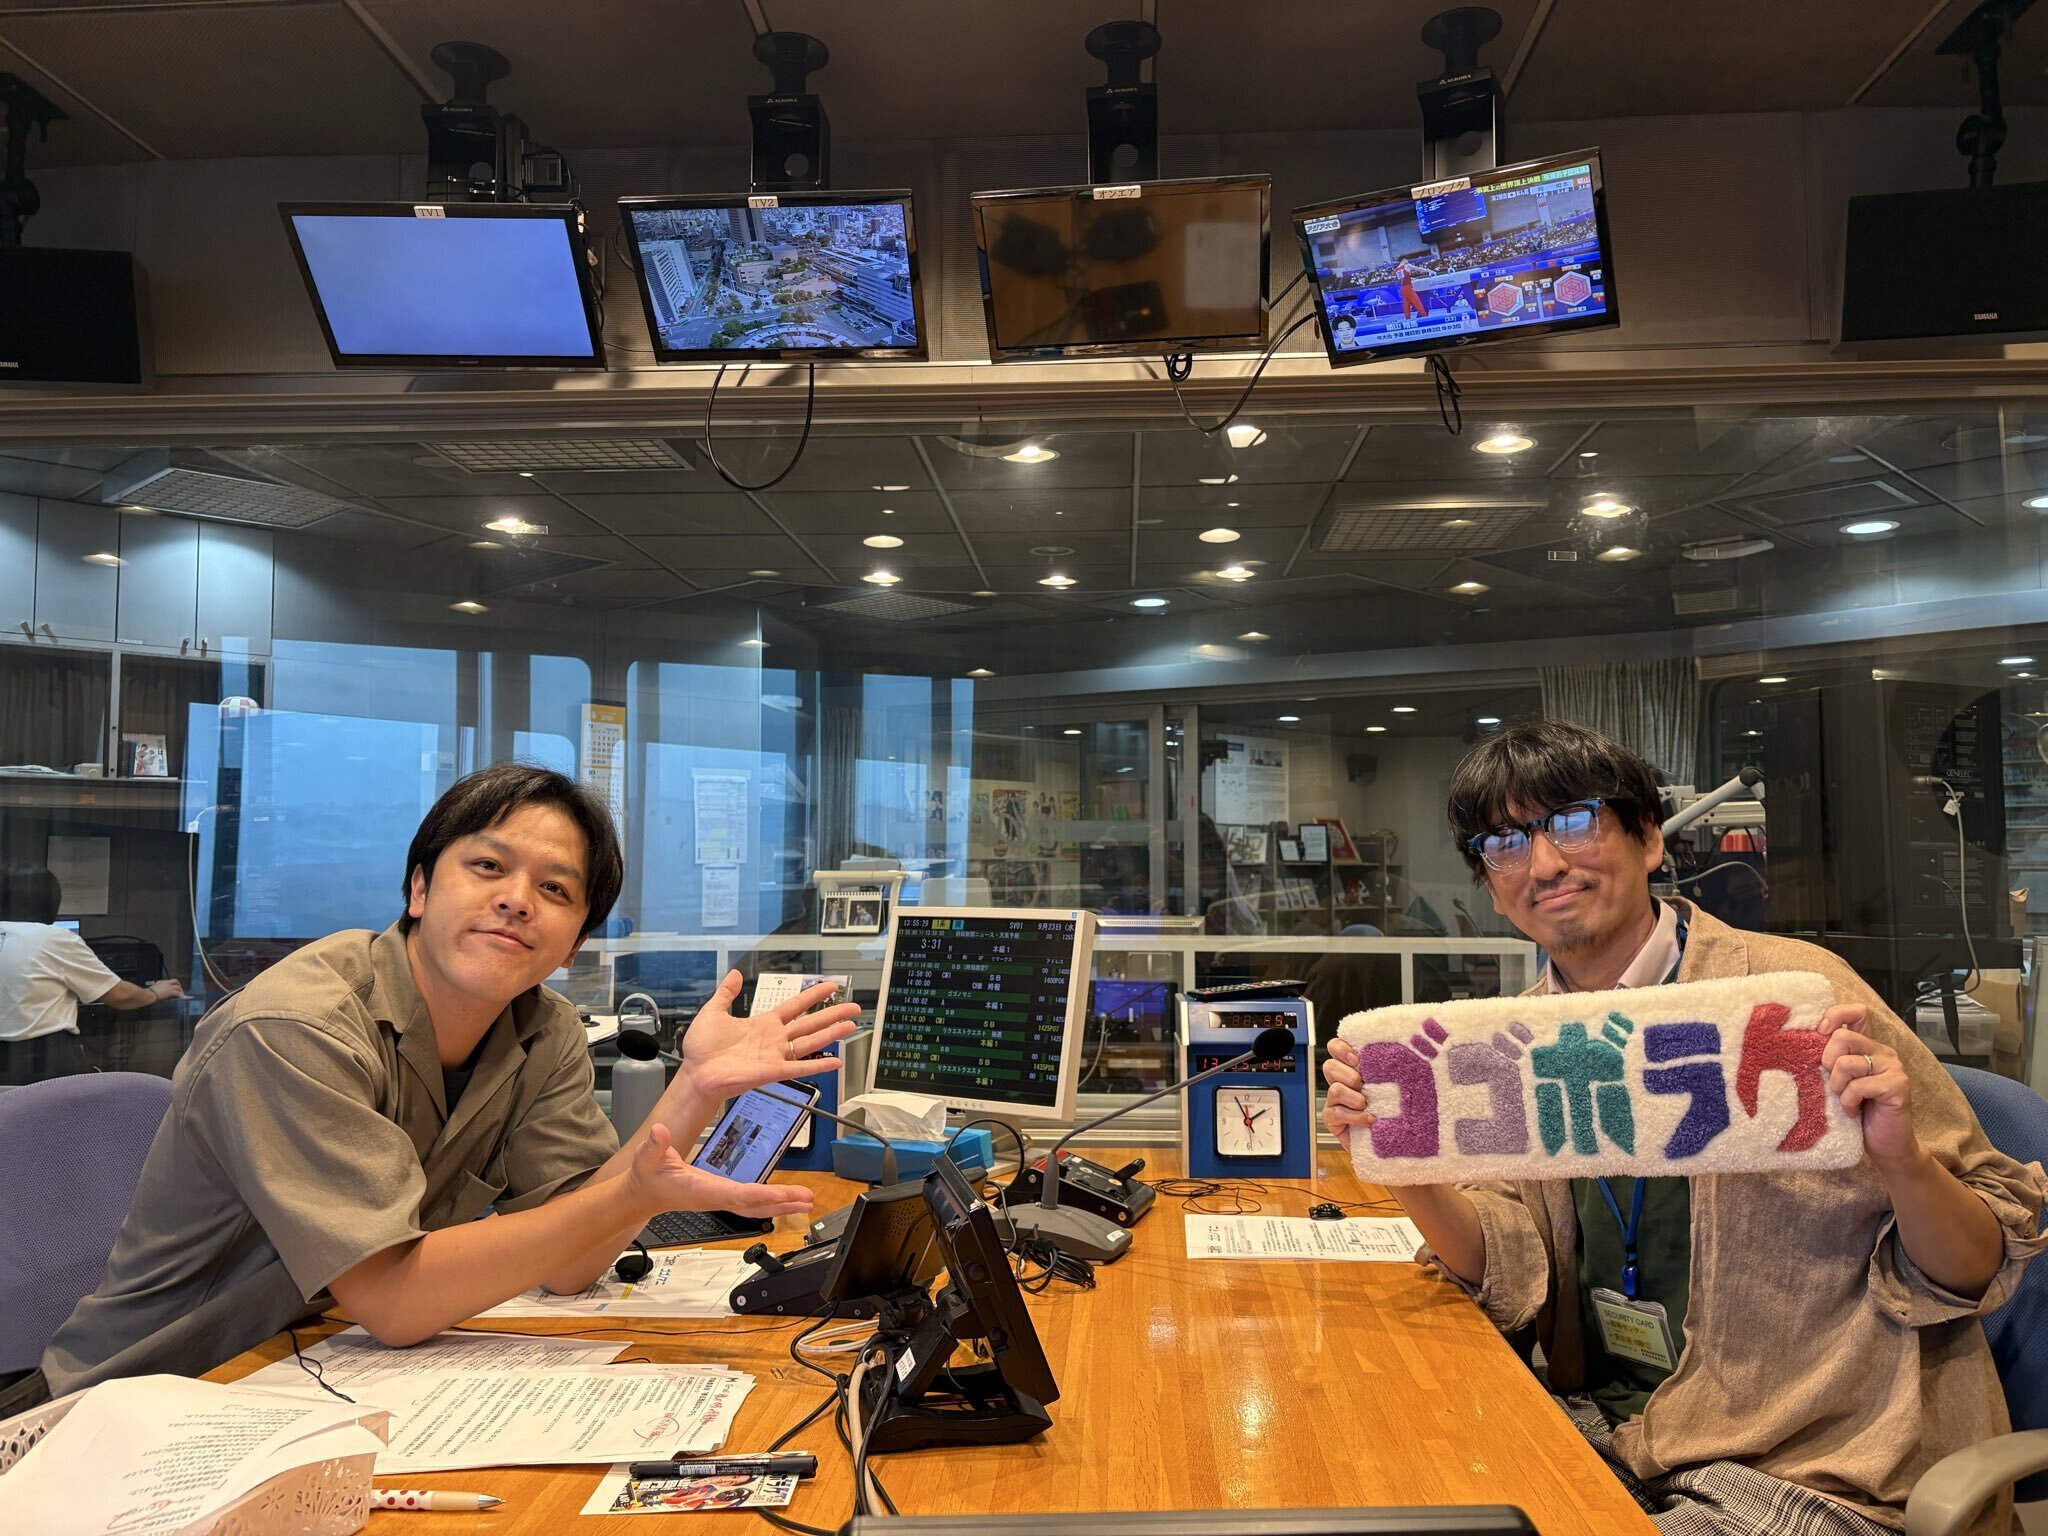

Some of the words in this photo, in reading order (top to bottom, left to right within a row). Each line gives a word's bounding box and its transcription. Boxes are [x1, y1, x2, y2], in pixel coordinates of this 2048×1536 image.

[1096, 188, 1137, 199] オンエア
[751, 198, 775, 208] TV2
[416, 209, 442, 217] TV1
[1974, 312, 1998, 320] YAMAHA
[0, 361, 19, 369] AMAHA
[1946, 769, 1973, 778] GENELEC
[1037, 922, 1061, 930] 9月23日
[920, 938, 941, 949] 3:31
[903, 996, 928, 1004] 14:00:02
[901, 1014, 925, 1022] 14:24:00
[905, 1033, 923, 1041] 01:00
[895, 1051, 920, 1059] 14:34:00
[900, 1070, 918, 1078] 01:00
[1360, 1001, 1830, 1160] ゴゴボラケ
[1244, 1094, 1250, 1102] 12
[1269, 1118, 1274, 1126] 3
[1603, 1309, 1634, 1323] SECURITY
[1636, 1318, 1654, 1329] CARD
